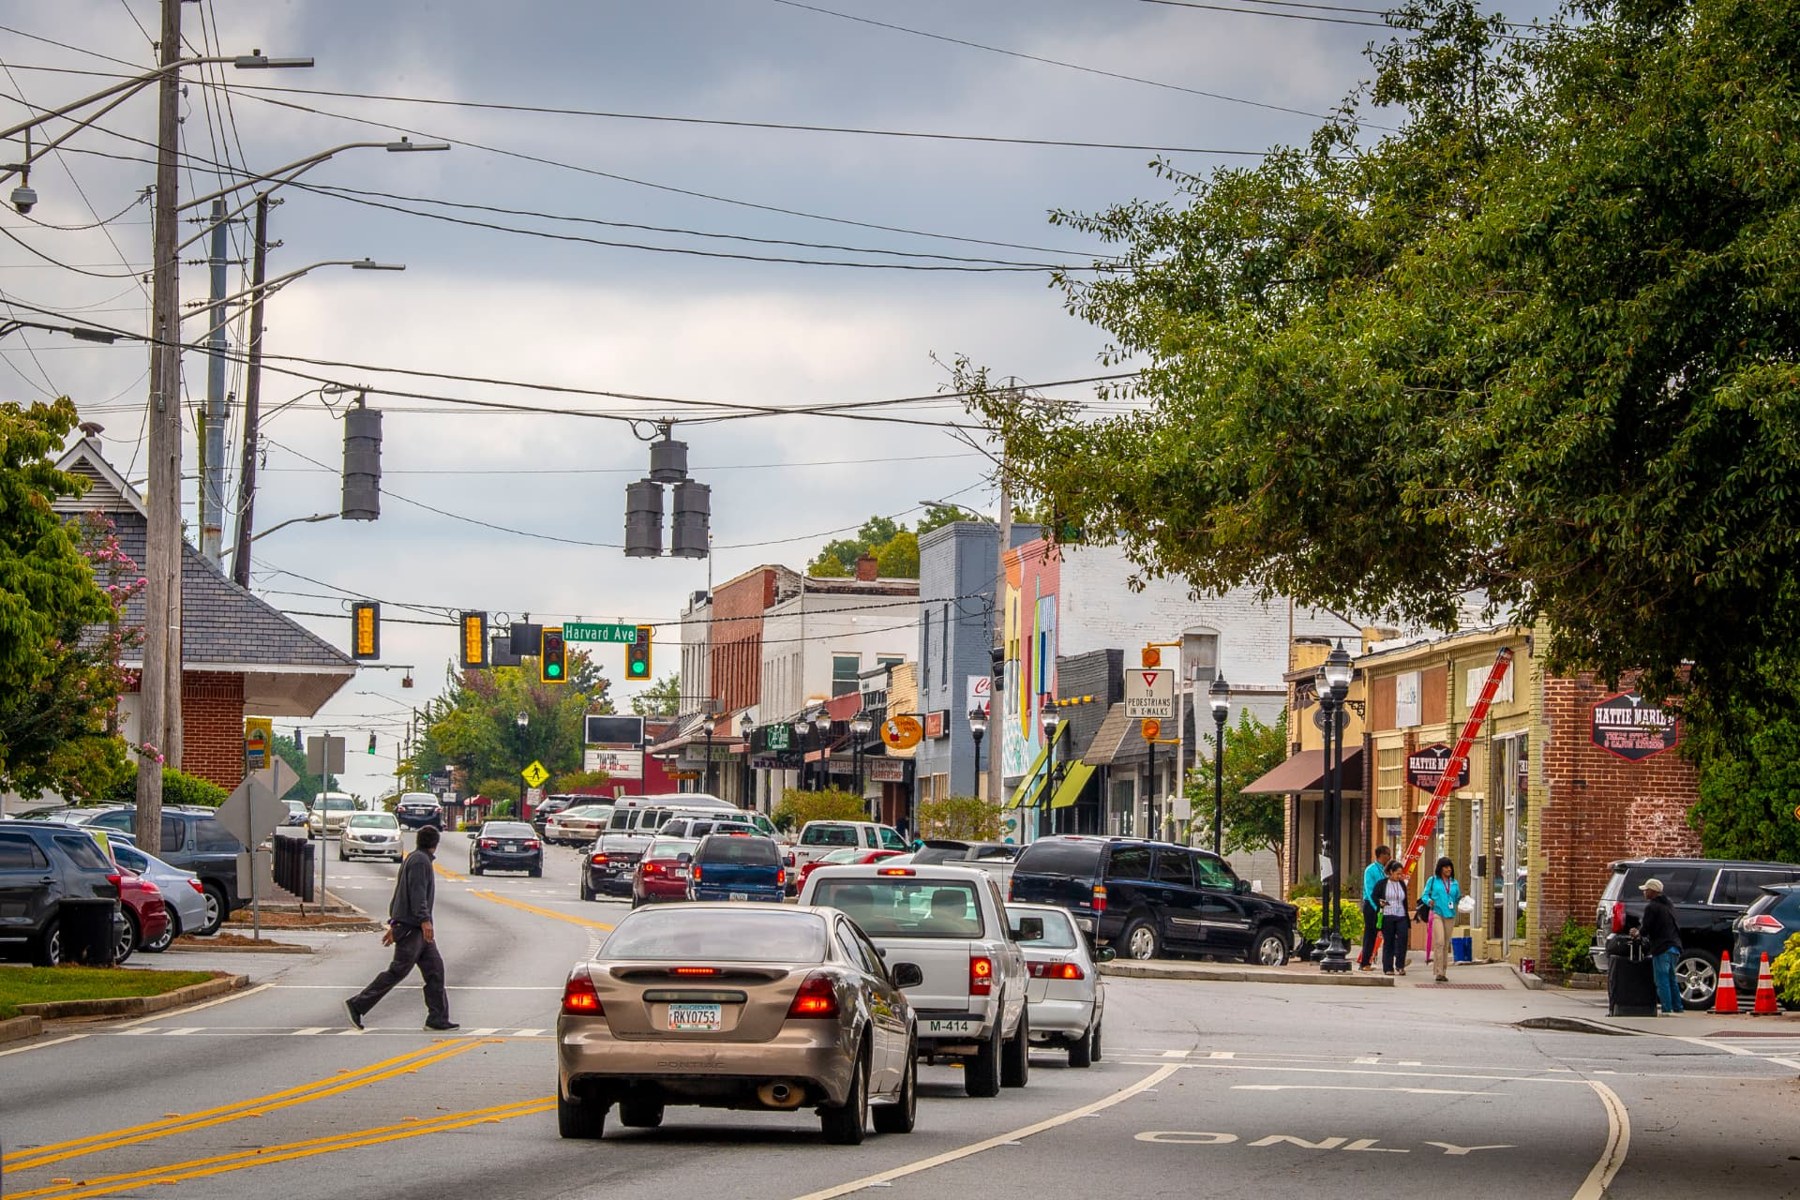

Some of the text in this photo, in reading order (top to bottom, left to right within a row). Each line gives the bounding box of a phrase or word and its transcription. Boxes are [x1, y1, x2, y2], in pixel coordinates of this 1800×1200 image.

[566, 625, 634, 641] Harvard Ave
[1128, 698, 1170, 707] PEDESTRIANS
[1595, 708, 1632, 725] HATTIE
[1410, 757, 1437, 770] HATTIE
[673, 1010, 715, 1024] RKY0753
[930, 1021, 969, 1032] M-414
[657, 1061, 728, 1072] PONTIAC
[1134, 1131, 1518, 1155] ONLY
